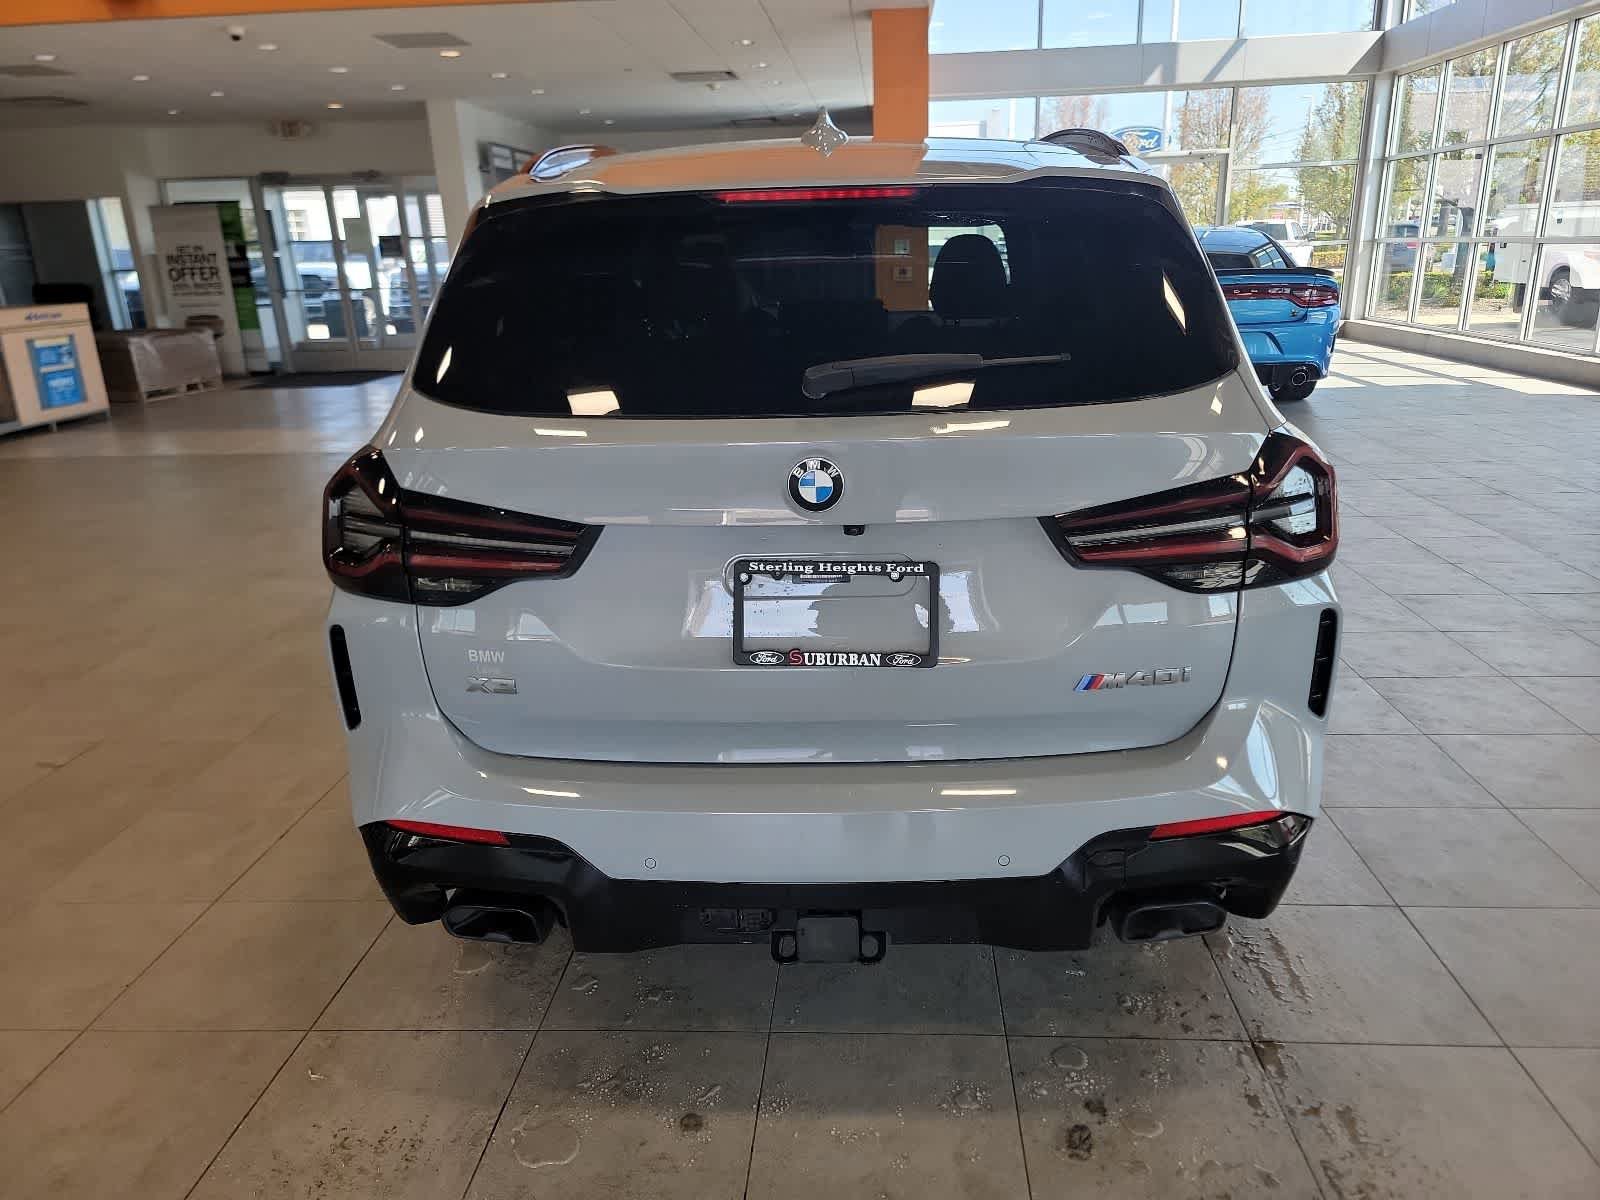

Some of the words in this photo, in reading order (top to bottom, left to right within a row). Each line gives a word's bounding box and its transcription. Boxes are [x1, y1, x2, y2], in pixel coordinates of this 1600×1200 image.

[166, 252, 217, 266] INSTANT
[168, 266, 220, 282] OFFER
[792, 459, 839, 478] BMW
[748, 561, 814, 574] Sterling
[818, 562, 882, 574] Heights
[886, 563, 925, 574] Ford
[468, 649, 505, 663] BMW
[755, 652, 779, 664] Ford
[788, 649, 882, 667] SUBURBAN
[892, 654, 915, 666] Ford
